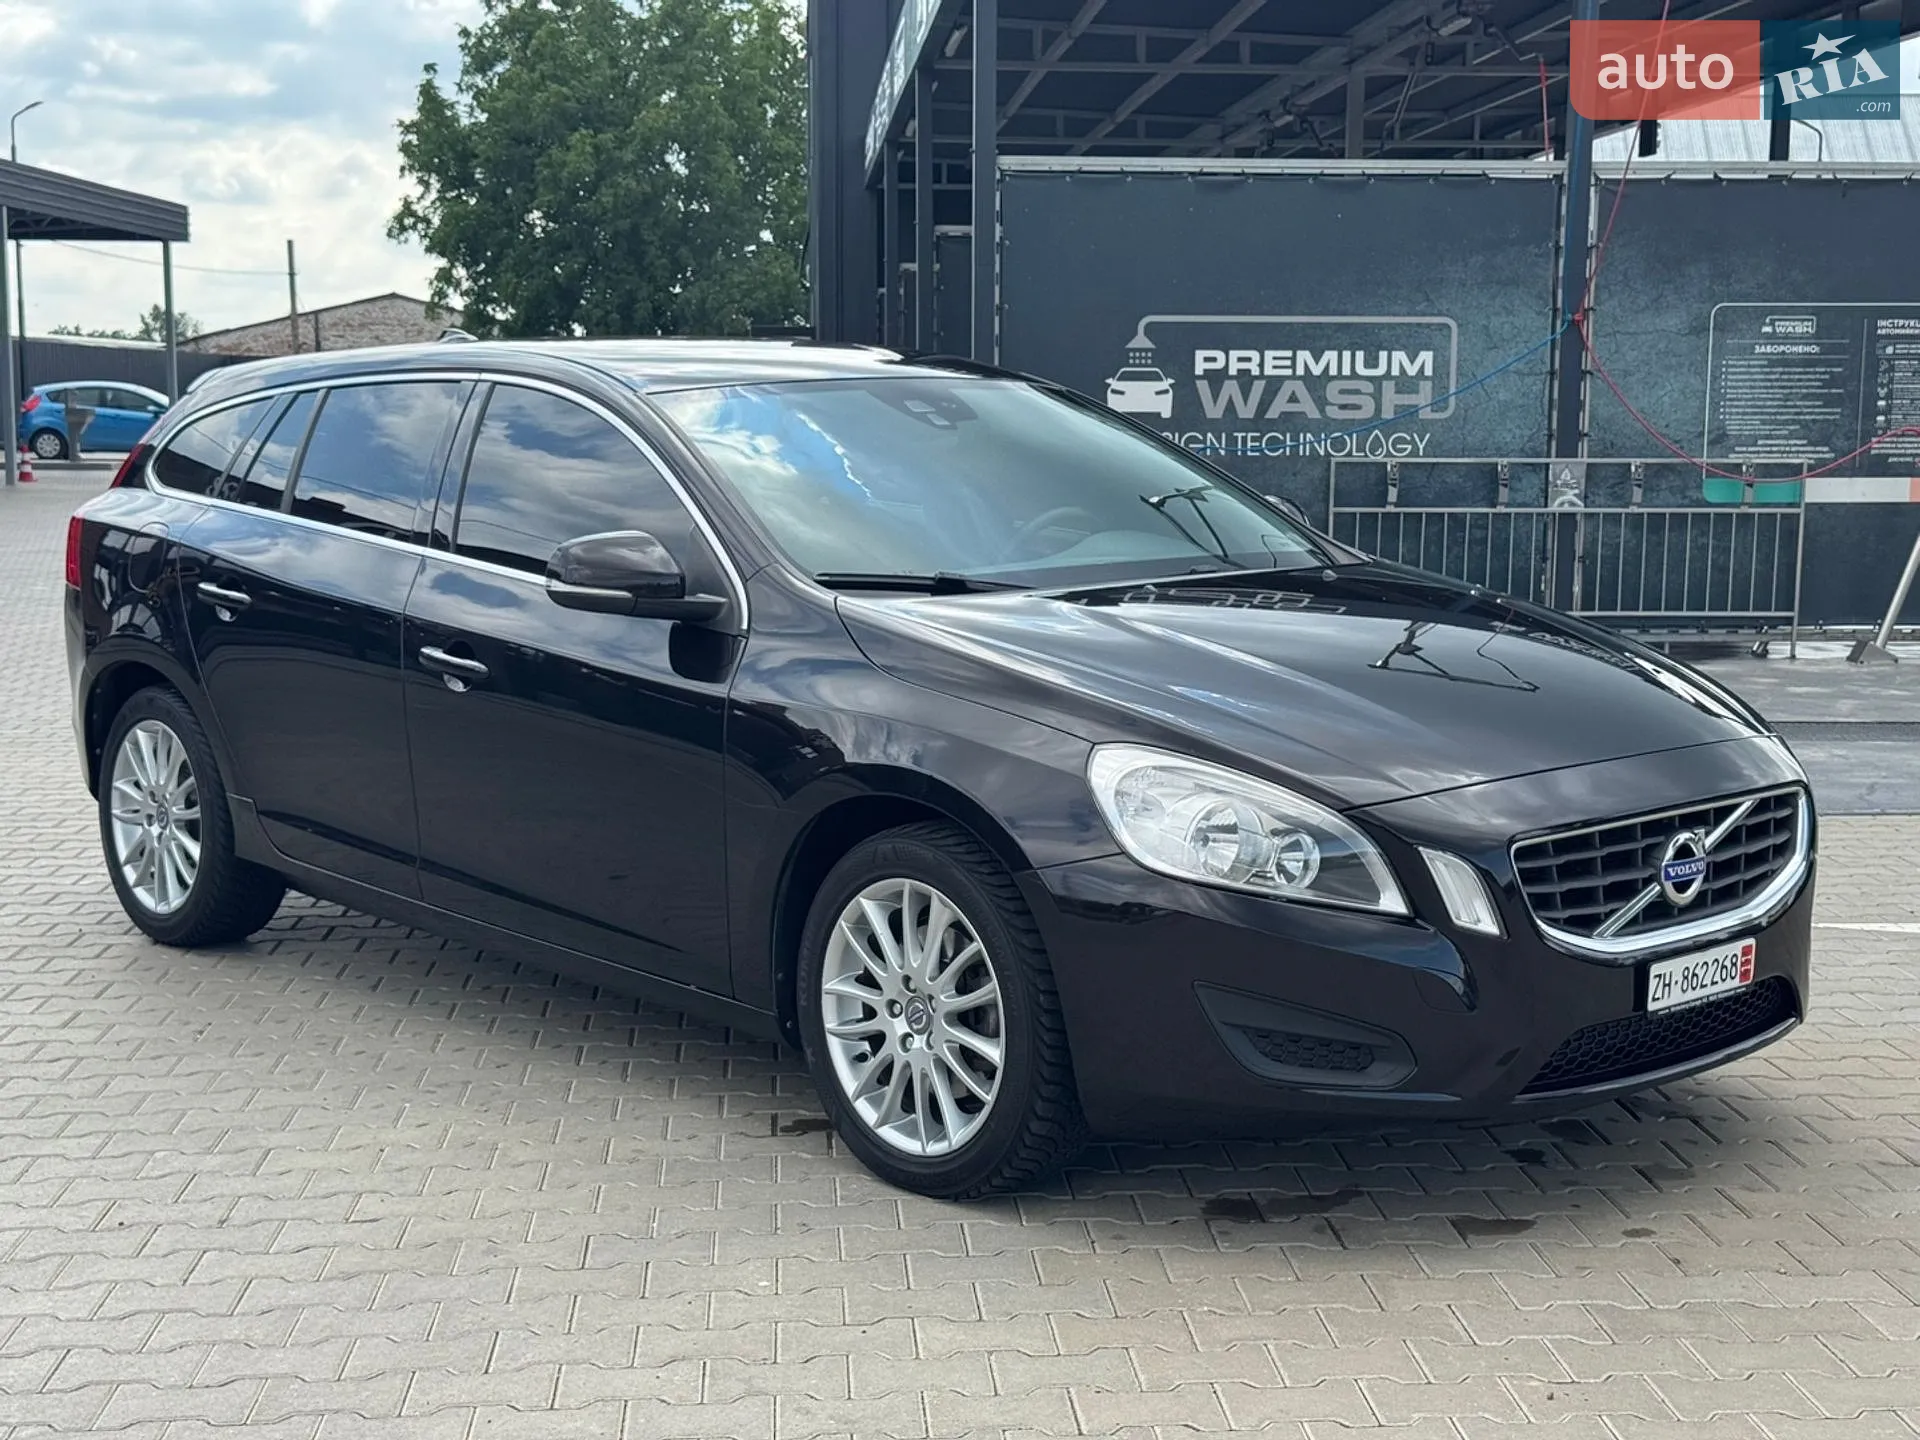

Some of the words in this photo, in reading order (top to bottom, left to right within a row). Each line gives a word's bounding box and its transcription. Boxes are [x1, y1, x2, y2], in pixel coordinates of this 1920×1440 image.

[1194, 349, 1434, 377] PREMIUM
[1195, 379, 1434, 419] WASH
[1667, 860, 1704, 877] VOLVO
